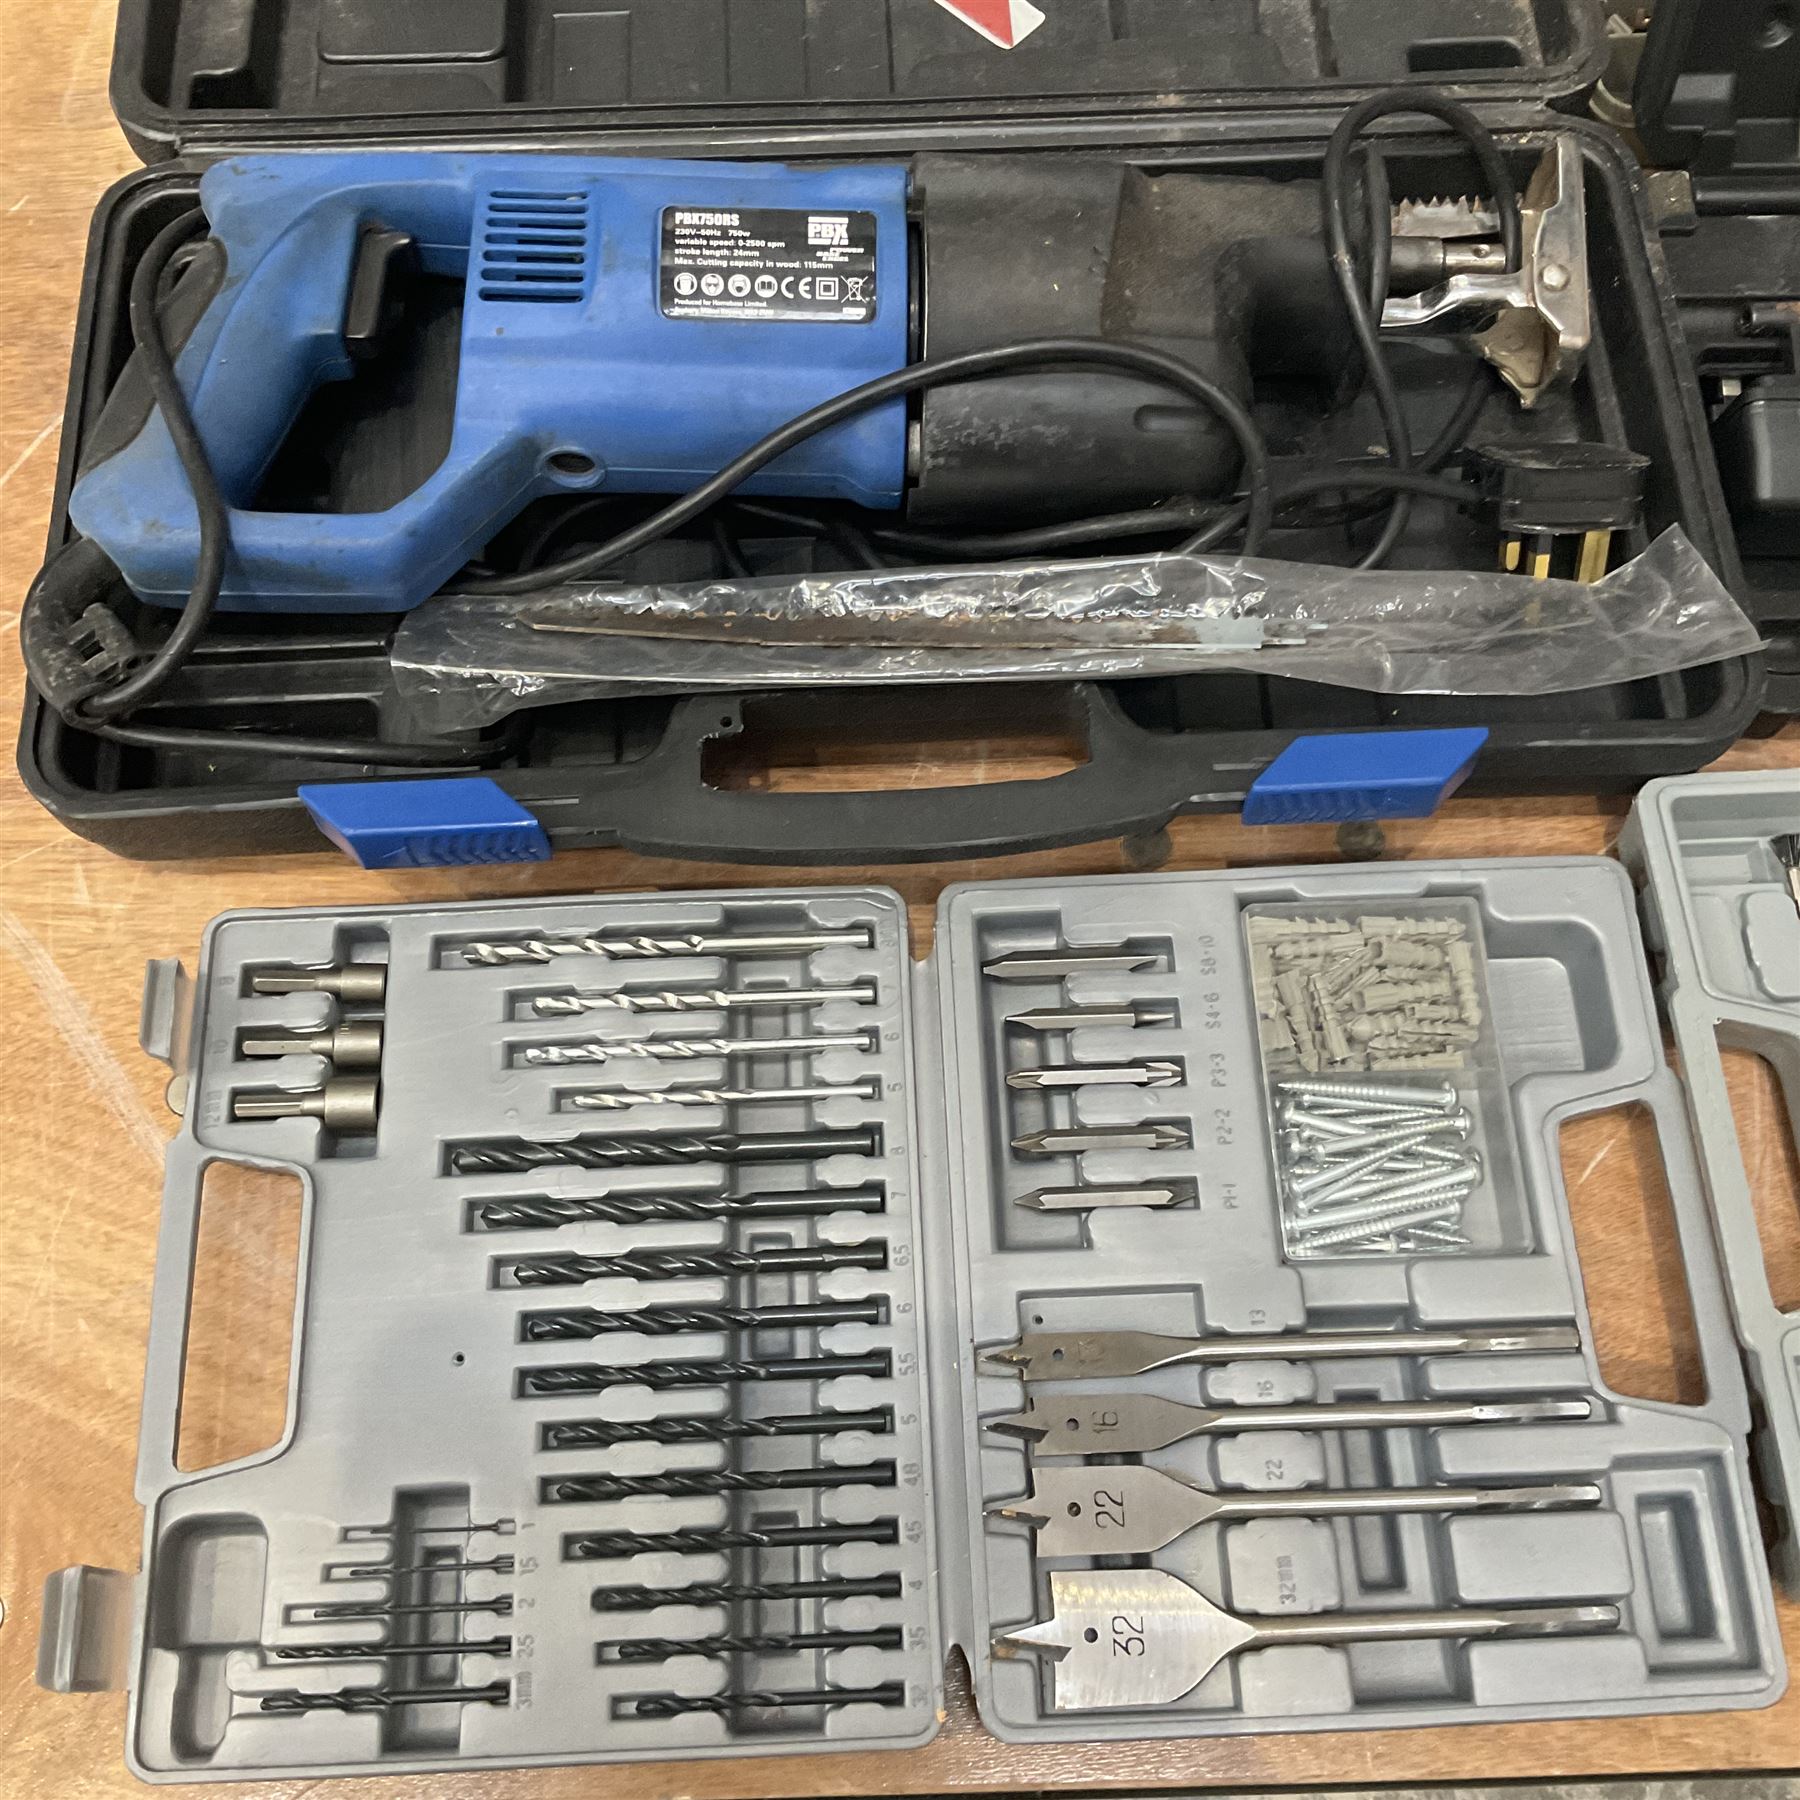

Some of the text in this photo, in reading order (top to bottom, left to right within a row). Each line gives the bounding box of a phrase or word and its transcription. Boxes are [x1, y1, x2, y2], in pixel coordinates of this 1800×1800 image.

[674, 212, 740, 226] PBX750RS
[728, 229, 751, 237] 750w
[807, 222, 849, 246] PBX
[674, 238, 708, 246] variable
[709, 239, 736, 247] speed:
[674, 247, 760, 257] stroke length: 24mm
[674, 257, 695, 265] Max.
[696, 258, 728, 268] Cutting
[729, 259, 764, 269] capacity
[765, 260, 775, 268] in
[803, 261, 834, 269] 115mm
[901, 1412, 918, 1426] 5
[1091, 1410, 1120, 1434] 16
[1265, 1458, 1284, 1481] 22
[1093, 1490, 1126, 1530] 22
[1111, 1615, 1146, 1657] 32
